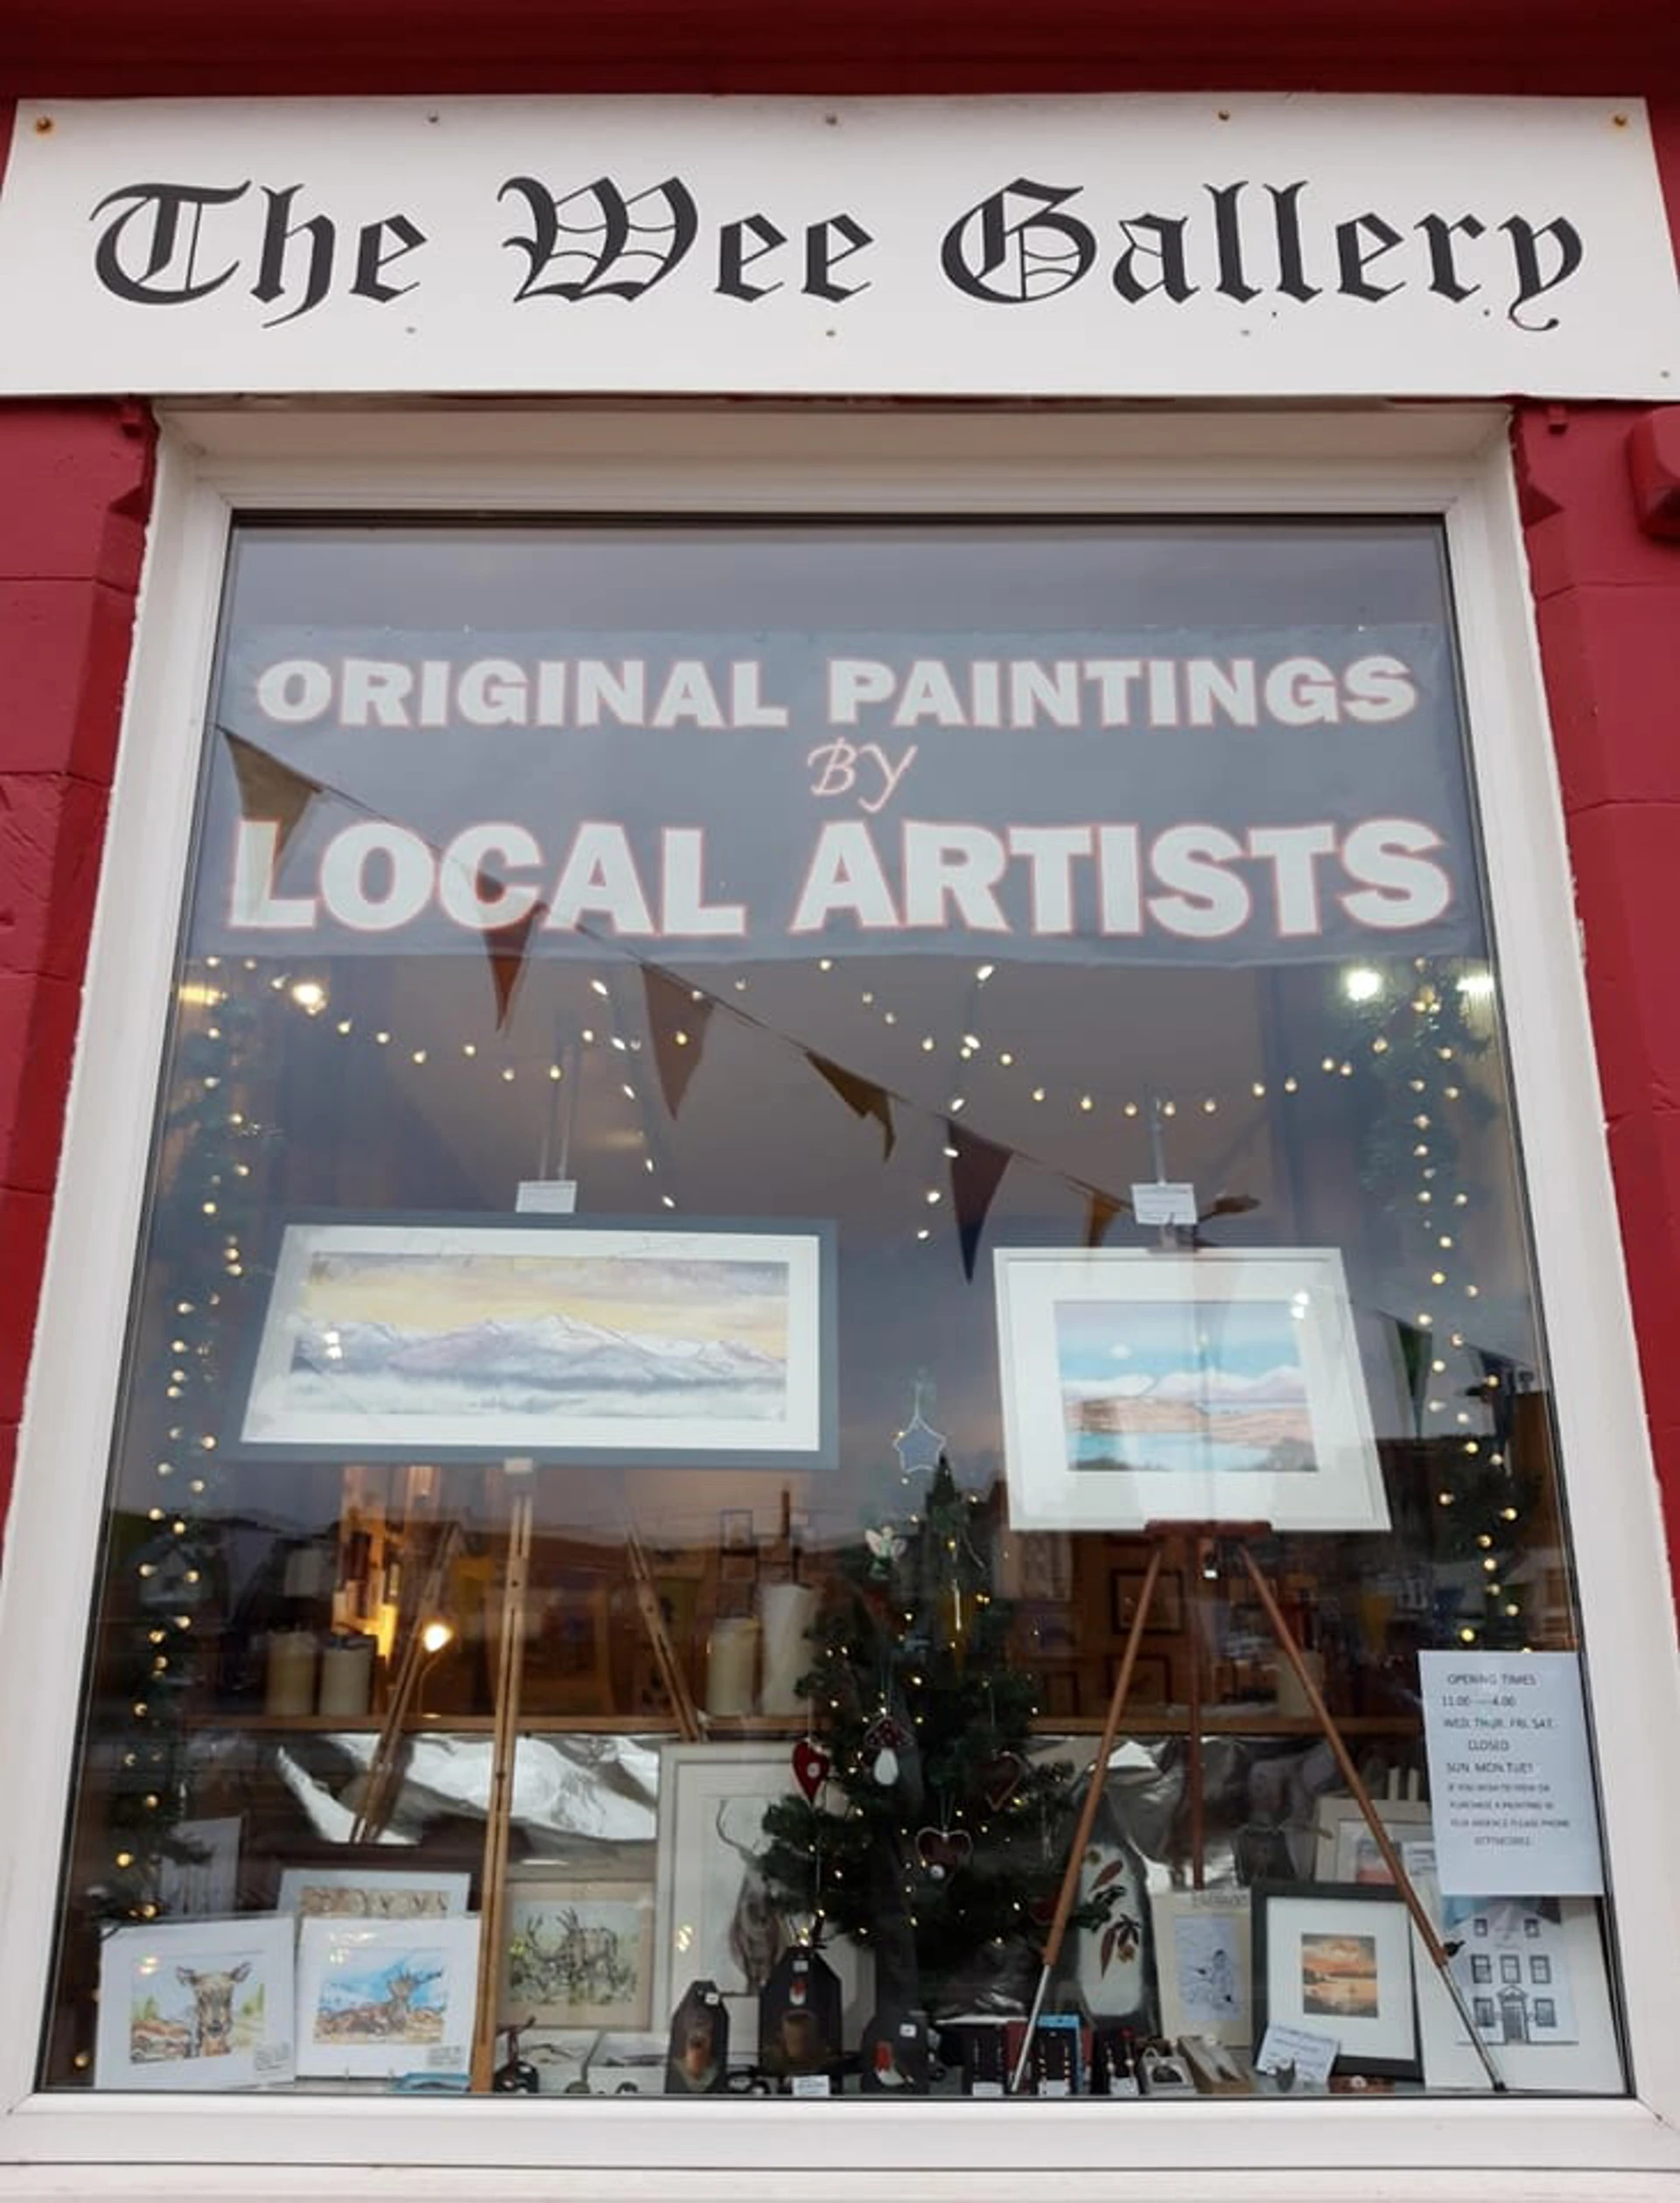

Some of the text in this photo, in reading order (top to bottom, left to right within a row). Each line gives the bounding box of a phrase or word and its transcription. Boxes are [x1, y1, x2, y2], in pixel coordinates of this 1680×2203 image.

[88, 176, 1584, 332] The Wee Gallery
[256, 654, 1418, 729] ORIGINAL PAINTINGS
[806, 736, 918, 814] BY
[228, 817, 1452, 939] LOCAL ARTISTS
[1446, 1672, 1537, 1687] OPENING TIMES
[1467, 1738, 1509, 1751] CLOSED
